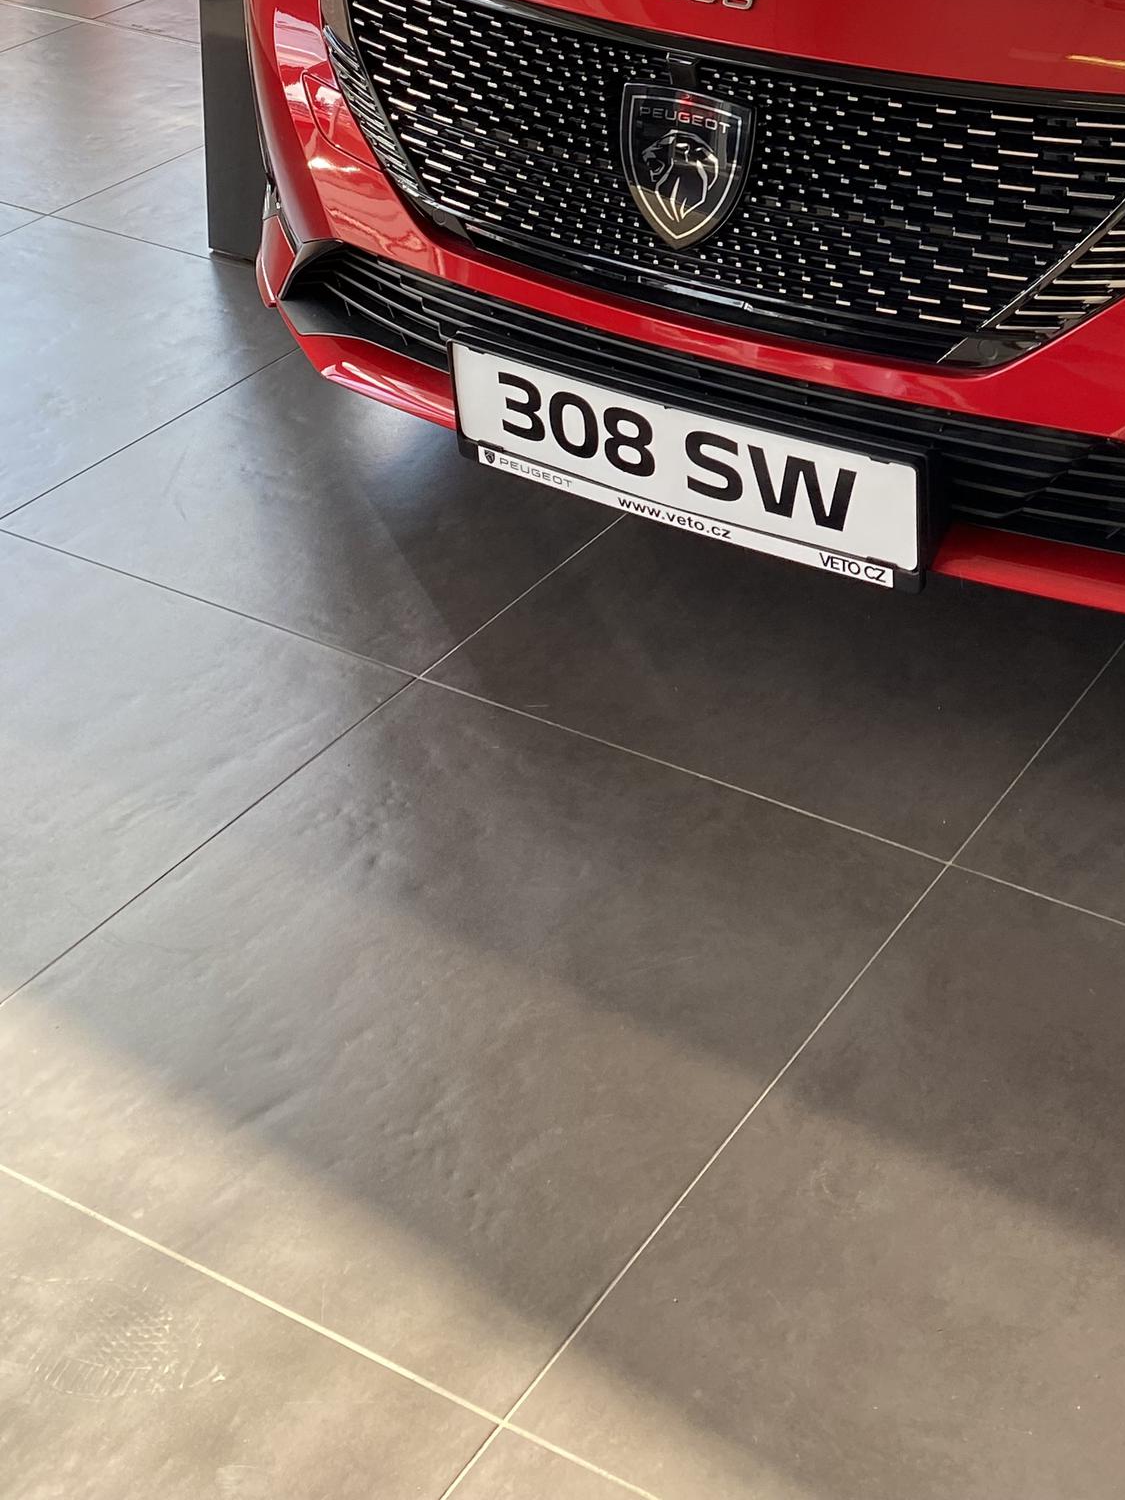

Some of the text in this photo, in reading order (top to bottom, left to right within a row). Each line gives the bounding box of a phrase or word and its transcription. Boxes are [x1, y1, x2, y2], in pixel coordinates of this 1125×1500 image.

[639, 105, 732, 134] PEUGEOT
[497, 371, 858, 533] 308 SW
[499, 457, 574, 488] PEUGEOT
[617, 496, 732, 540] www.veto.cz
[819, 552, 887, 583] VETO CZ
